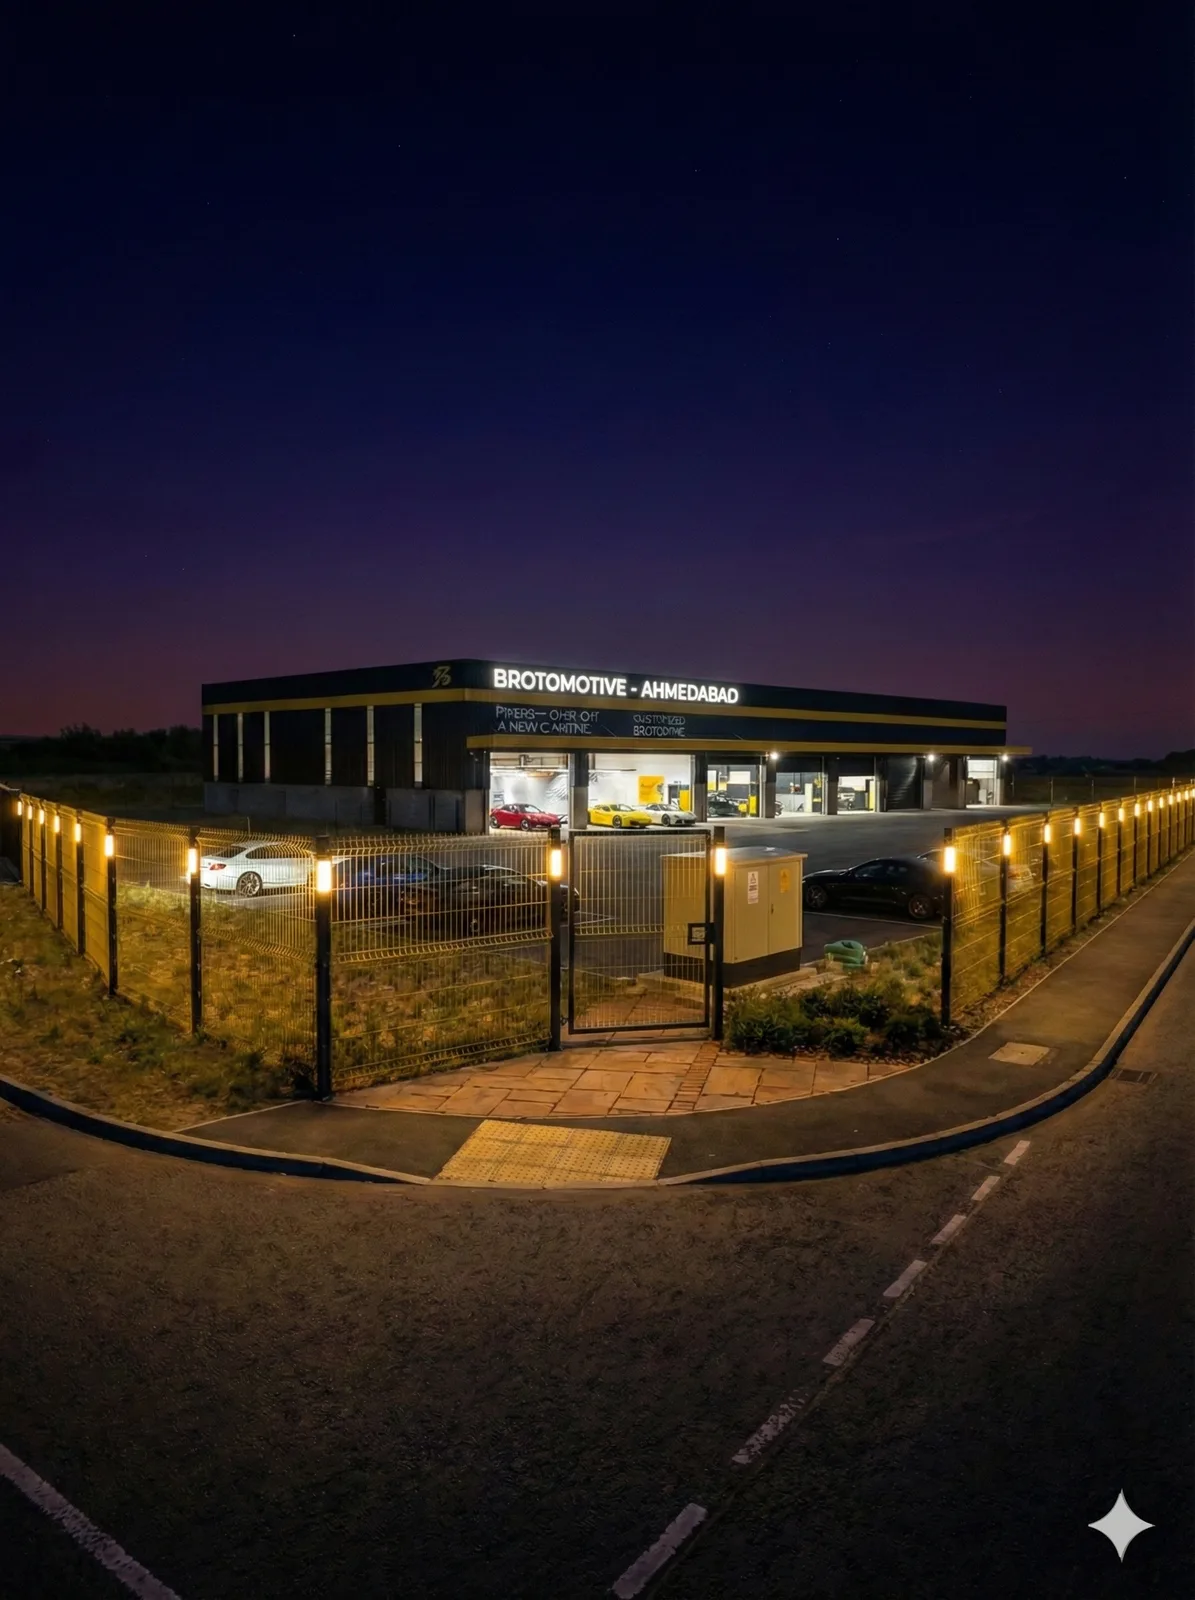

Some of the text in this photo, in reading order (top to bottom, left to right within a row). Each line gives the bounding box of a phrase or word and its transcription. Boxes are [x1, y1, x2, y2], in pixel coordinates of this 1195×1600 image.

[493, 668, 627, 696] BROTOMOTIVE
[641, 680, 739, 704] AHMEDABAD
[509, 720, 538, 733] NEW
